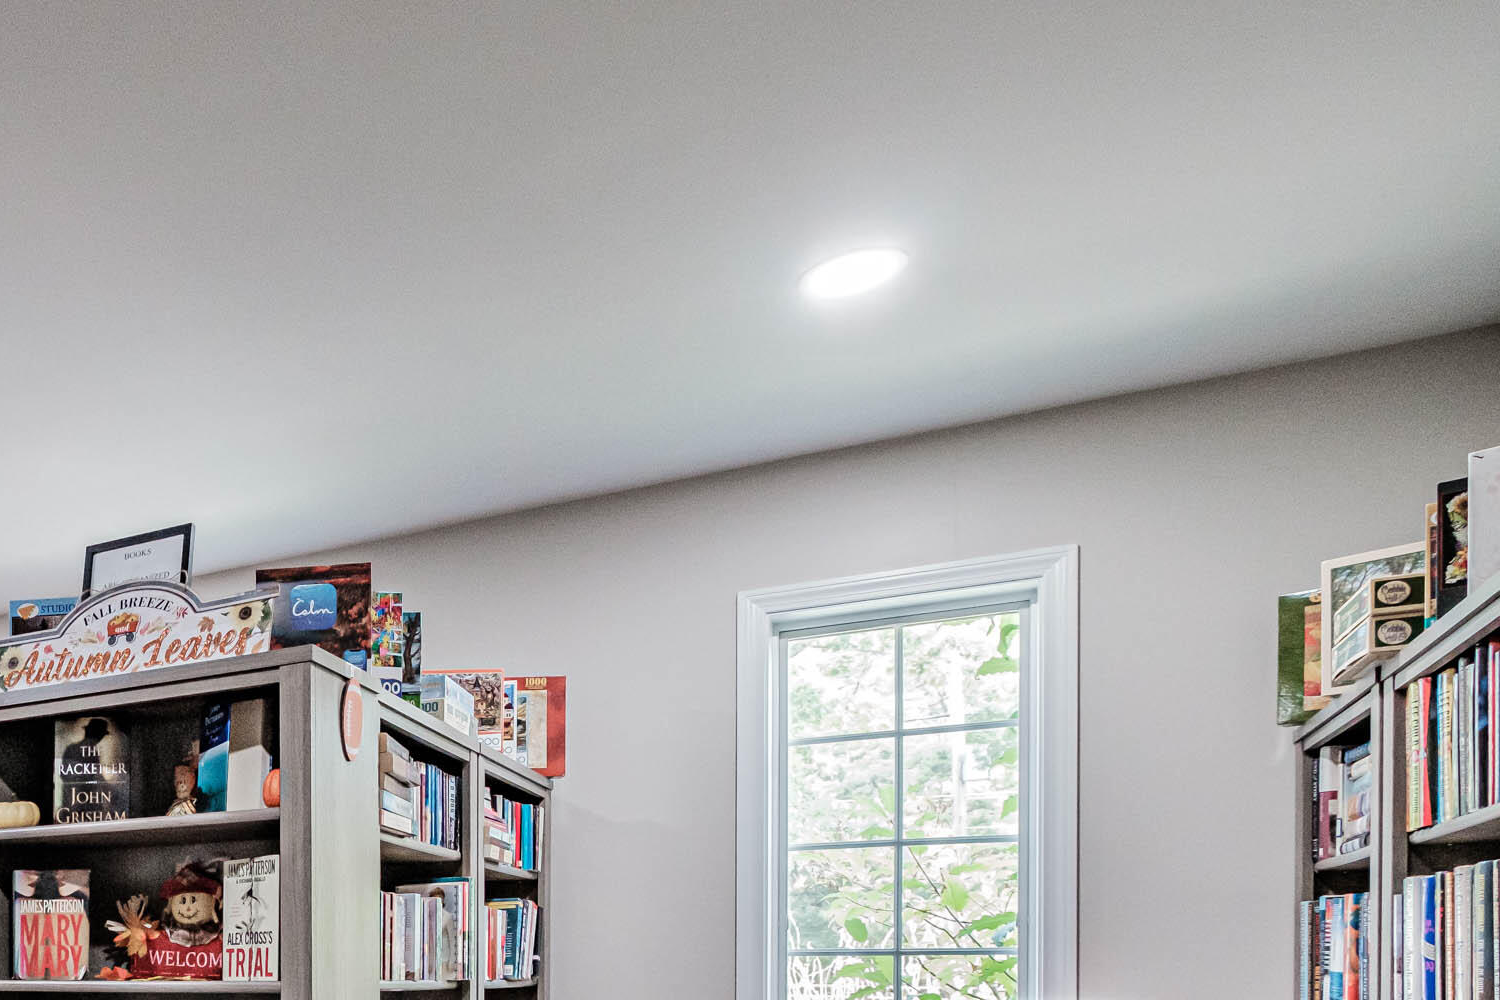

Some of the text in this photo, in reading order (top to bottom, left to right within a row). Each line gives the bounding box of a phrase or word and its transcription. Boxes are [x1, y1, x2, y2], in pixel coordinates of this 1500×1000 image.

[124, 548, 152, 560] BOOKS
[41, 603, 76, 614] STUDIO
[83, 595, 174, 627] FALL BREEZE
[292, 597, 334, 617] Calm
[4, 625, 255, 689] Autumn Leaves
[525, 677, 547, 688] 1000
[58, 763, 127, 776] RACKETEER
[71, 786, 112, 806] JOHN
[56, 807, 127, 825] GRISHAM
[226, 859, 276, 878] JAMES PATTERSON
[20, 898, 85, 913] JAMES PATTERSON
[20, 913, 84, 946] MARY
[227, 930, 273, 945] ALEX CROSS'S
[20, 943, 84, 978] MARY
[148, 948, 223, 968] WELCOM
[225, 946, 273, 978] TRIAL
